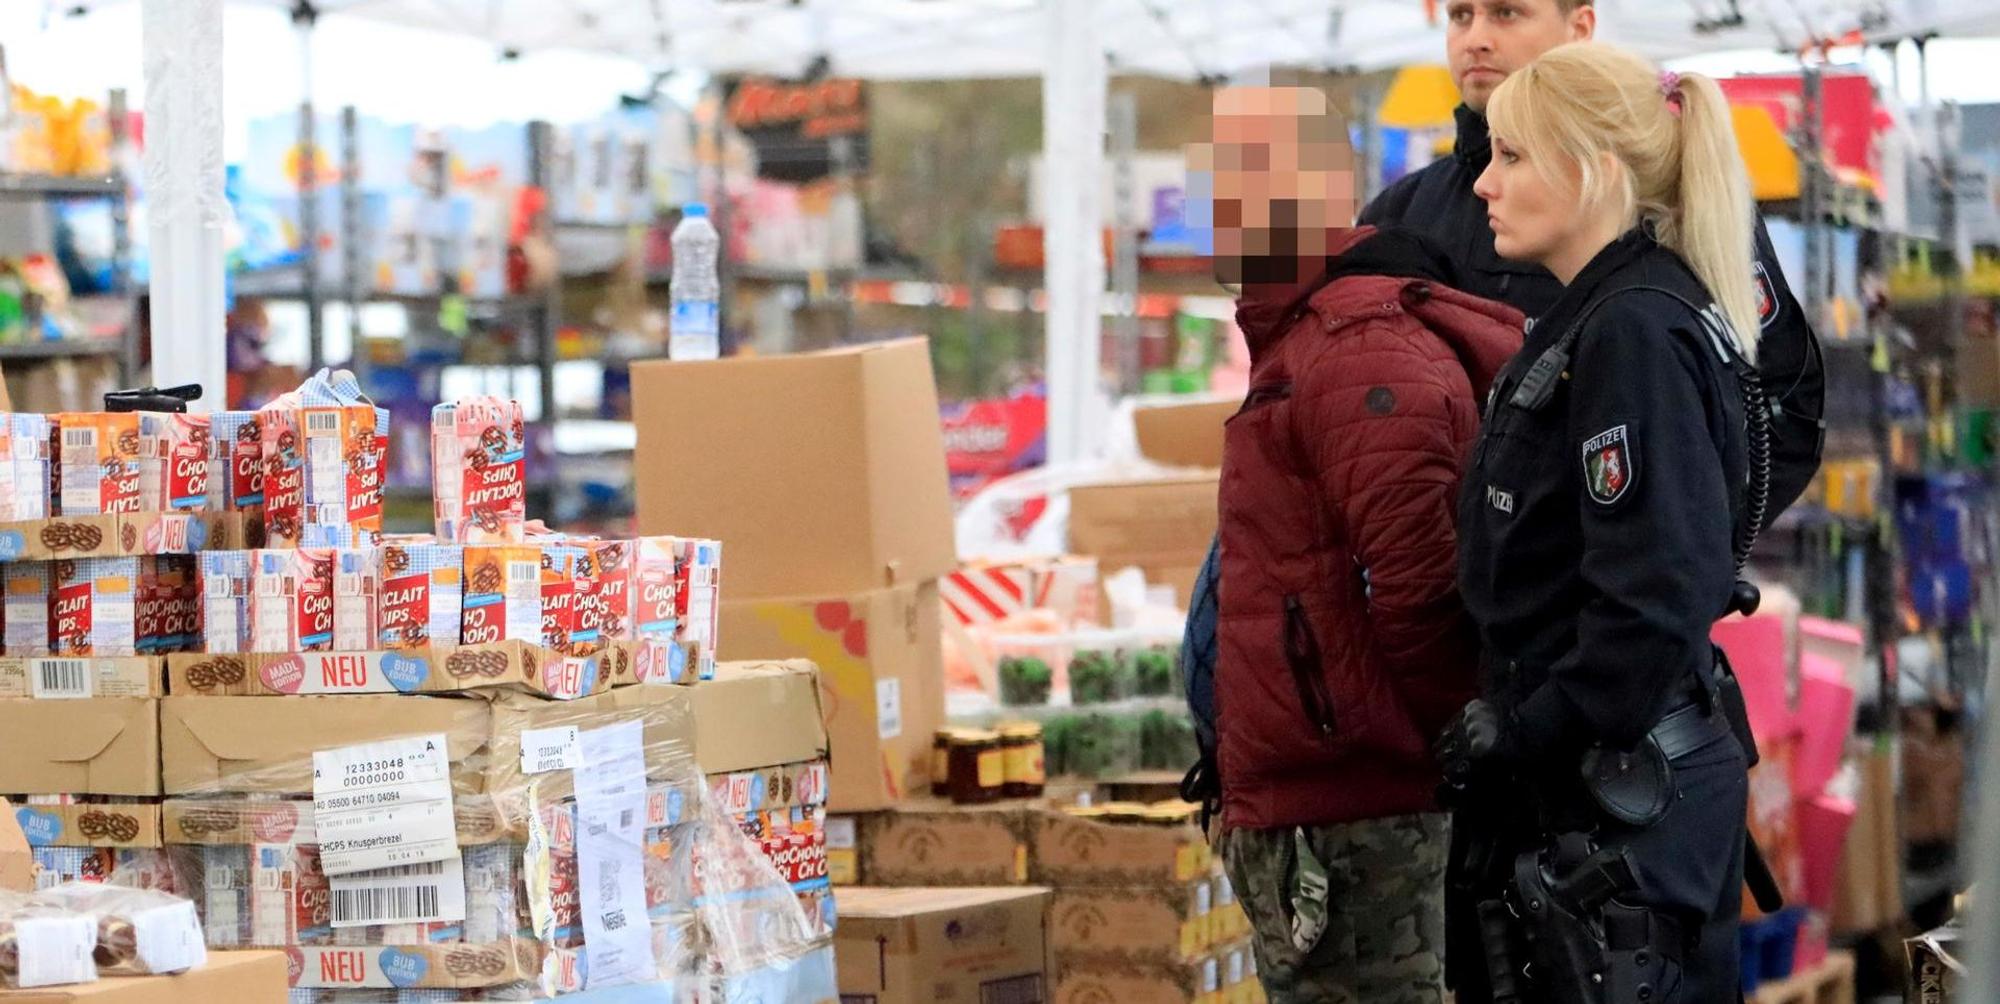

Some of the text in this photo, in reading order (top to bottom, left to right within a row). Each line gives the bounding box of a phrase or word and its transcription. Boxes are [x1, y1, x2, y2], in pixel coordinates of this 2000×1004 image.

[1583, 429, 1625, 457] POLIZEI
[164, 519, 186, 550] NEU
[303, 595, 332, 614] CHO
[382, 586, 426, 608] CLAIT
[321, 656, 367, 687] NEU
[345, 758, 404, 775] 12333048
[343, 770, 404, 787] 00000000
[348, 833, 403, 850] Knusperbrezel
[319, 951, 365, 982] NEU
